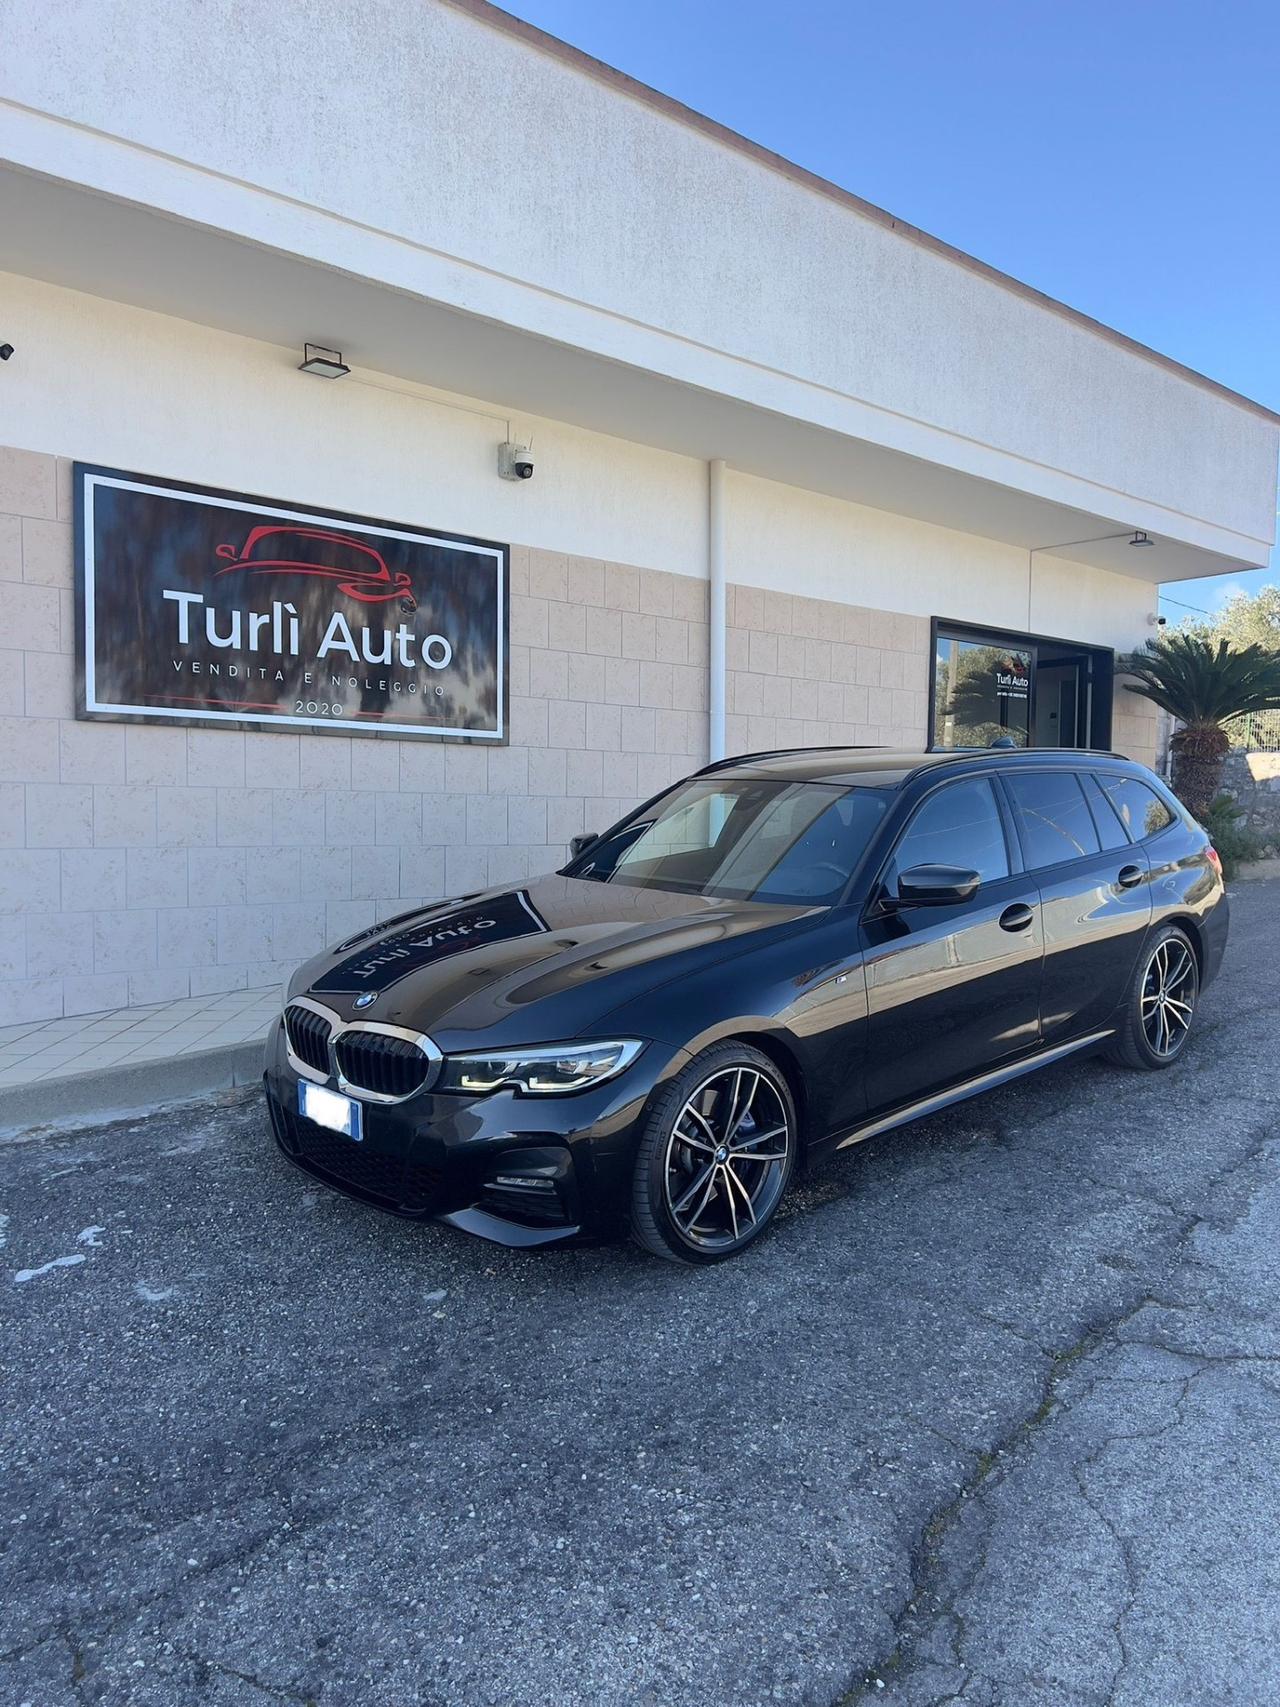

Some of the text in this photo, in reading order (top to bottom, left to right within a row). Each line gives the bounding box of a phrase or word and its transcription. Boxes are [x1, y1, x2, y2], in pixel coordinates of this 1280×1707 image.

[163, 589, 454, 671] Turlì Auto
[172, 660, 445, 697] VENDITA E NOLEGGIO
[295, 700, 344, 717] 2020
